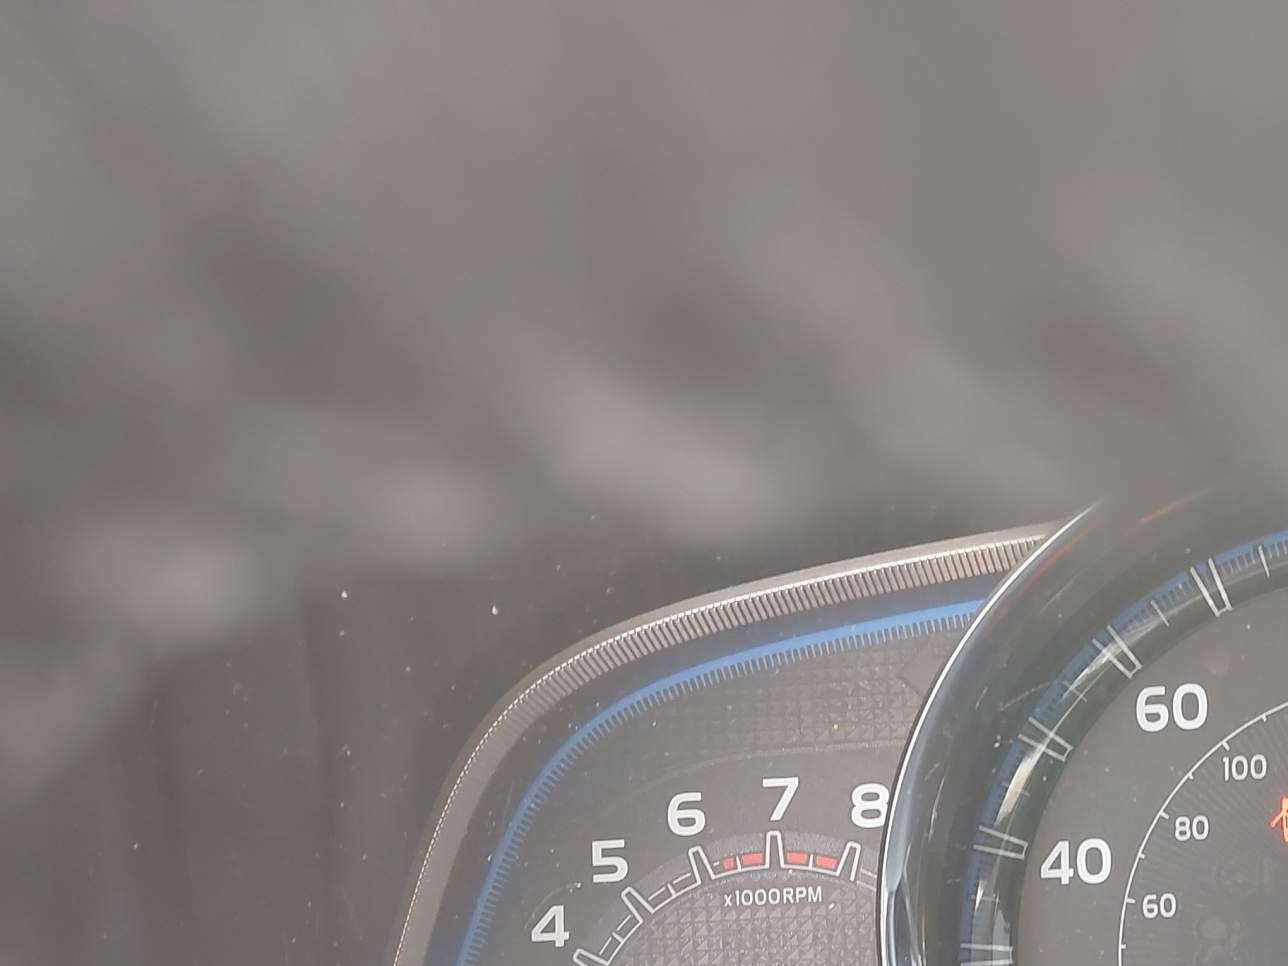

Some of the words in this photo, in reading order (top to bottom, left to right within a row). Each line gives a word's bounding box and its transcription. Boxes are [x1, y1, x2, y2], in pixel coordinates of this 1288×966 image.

[1135, 683, 1209, 732] 60
[1222, 753, 1268, 781] 100
[667, 792, 706, 835] 6
[762, 777, 799, 821] 7
[851, 783, 890, 828] 8
[1174, 815, 1210, 842] 80
[591, 839, 629, 883] 5
[1041, 838, 1113, 886] 40
[531, 905, 570, 948] 4
[1142, 893, 1178, 919] 60
